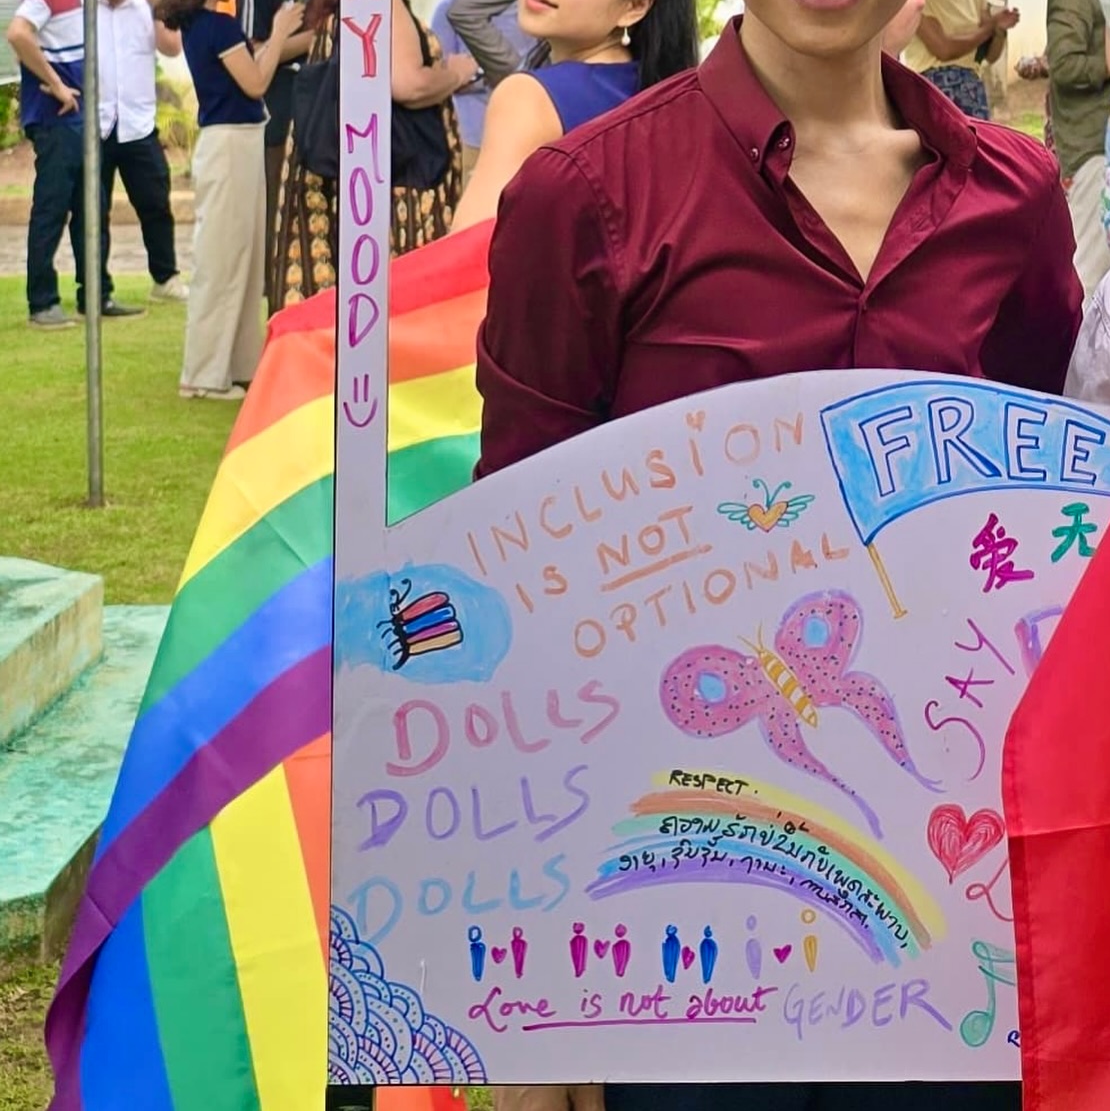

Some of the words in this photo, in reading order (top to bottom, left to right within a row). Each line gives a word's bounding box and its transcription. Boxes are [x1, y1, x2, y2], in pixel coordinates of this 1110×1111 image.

[344, 113, 385, 348] MOOD
[858, 396, 1106, 497] FREE
[515, 565, 568, 614] IS
[595, 505, 694, 574] NOT
[574, 531, 851, 658] OPTIONAL
[385, 679, 621, 777] DOLLS
[924, 617, 1016, 781] SAY
[356, 764, 591, 852] DOLLS
[347, 853, 571, 945] DOLLS
[469, 987, 556, 1032] Love
[582, 990, 601, 1018] is
[620, 989, 674, 1019] not
[689, 986, 778, 1020] about
[783, 979, 952, 1040] GENDER
